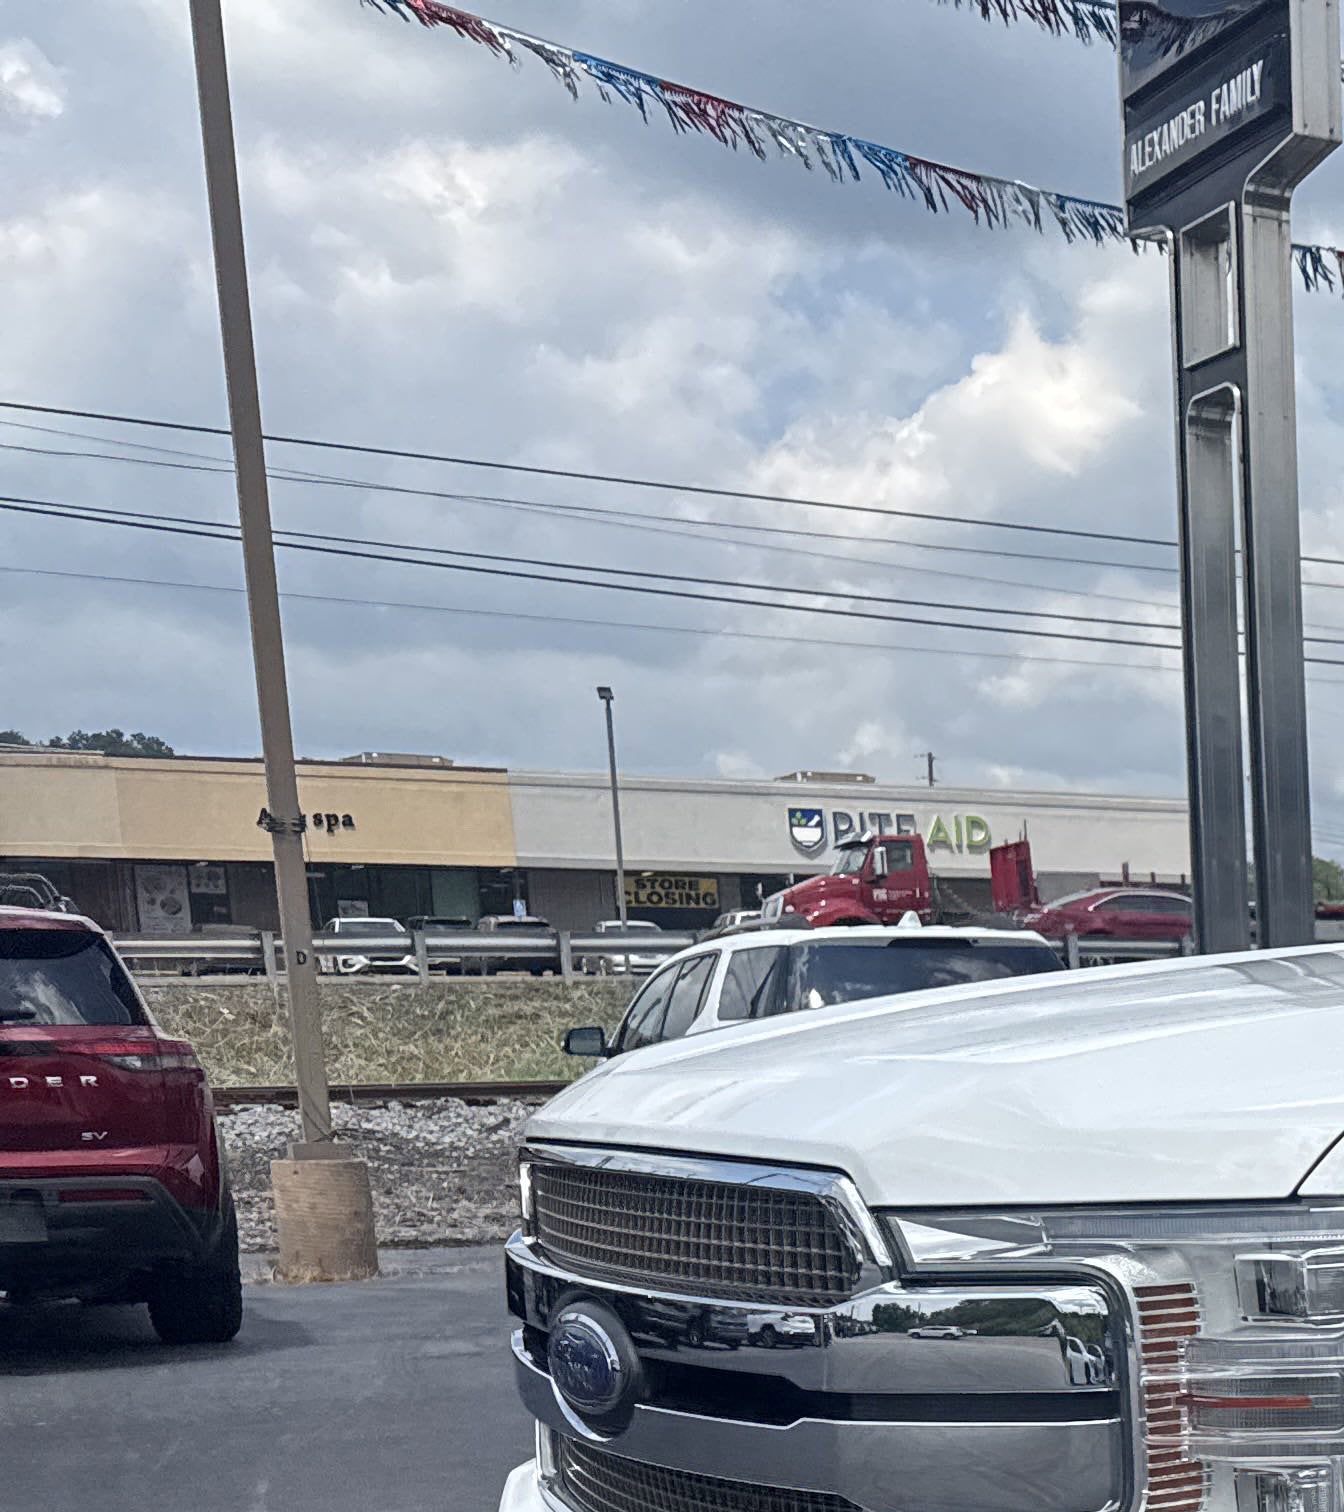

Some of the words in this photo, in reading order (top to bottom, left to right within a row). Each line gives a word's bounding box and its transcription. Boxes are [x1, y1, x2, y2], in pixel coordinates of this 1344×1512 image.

[1130, 99, 1205, 177] ALEXANDER
[1211, 59, 1263, 127] FAMILY
[313, 812, 355, 834] spa
[927, 815, 992, 849] AID
[634, 879, 699, 892] STORE
[80, 1131, 108, 1141] SV
